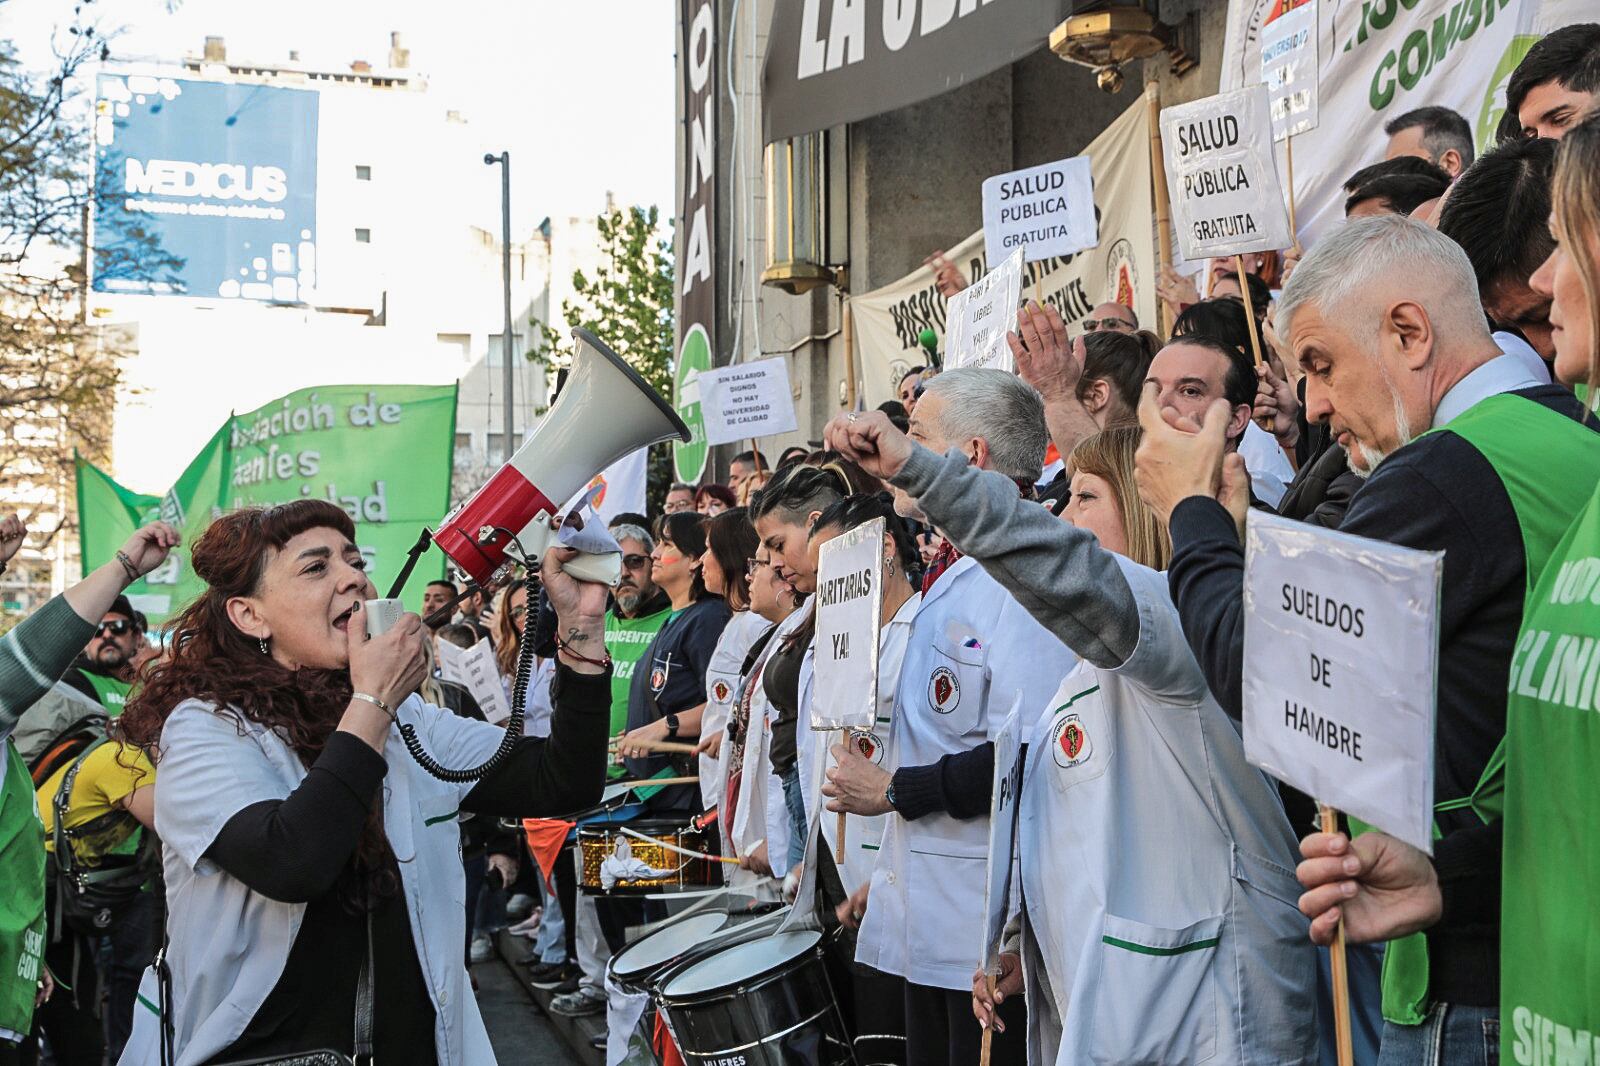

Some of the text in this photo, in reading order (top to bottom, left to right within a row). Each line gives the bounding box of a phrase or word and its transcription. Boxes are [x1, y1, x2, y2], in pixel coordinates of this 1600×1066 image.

[798, 0, 865, 80] LA
[1178, 115, 1239, 156] SALUD
[125, 157, 288, 203] MEDICUS
[1000, 171, 1064, 200] SALUD
[1003, 224, 1068, 248] GRATUITA
[1193, 213, 1256, 240] GRATUITA
[718, 371, 766, 384] SIN SALARIOS
[729, 383, 757, 393] DIGNOS
[350, 391, 401, 427] de
[722, 404, 770, 416] UNIVERSIDAD
[744, 394, 759, 402] HAY
[726, 414, 768, 426] DE CALIDAD
[1282, 583, 1365, 638] SUELDOS
[1310, 653, 1332, 688] DE
[1508, 629, 1600, 714] CLINI
[1285, 700, 1363, 761] HAMBRE
